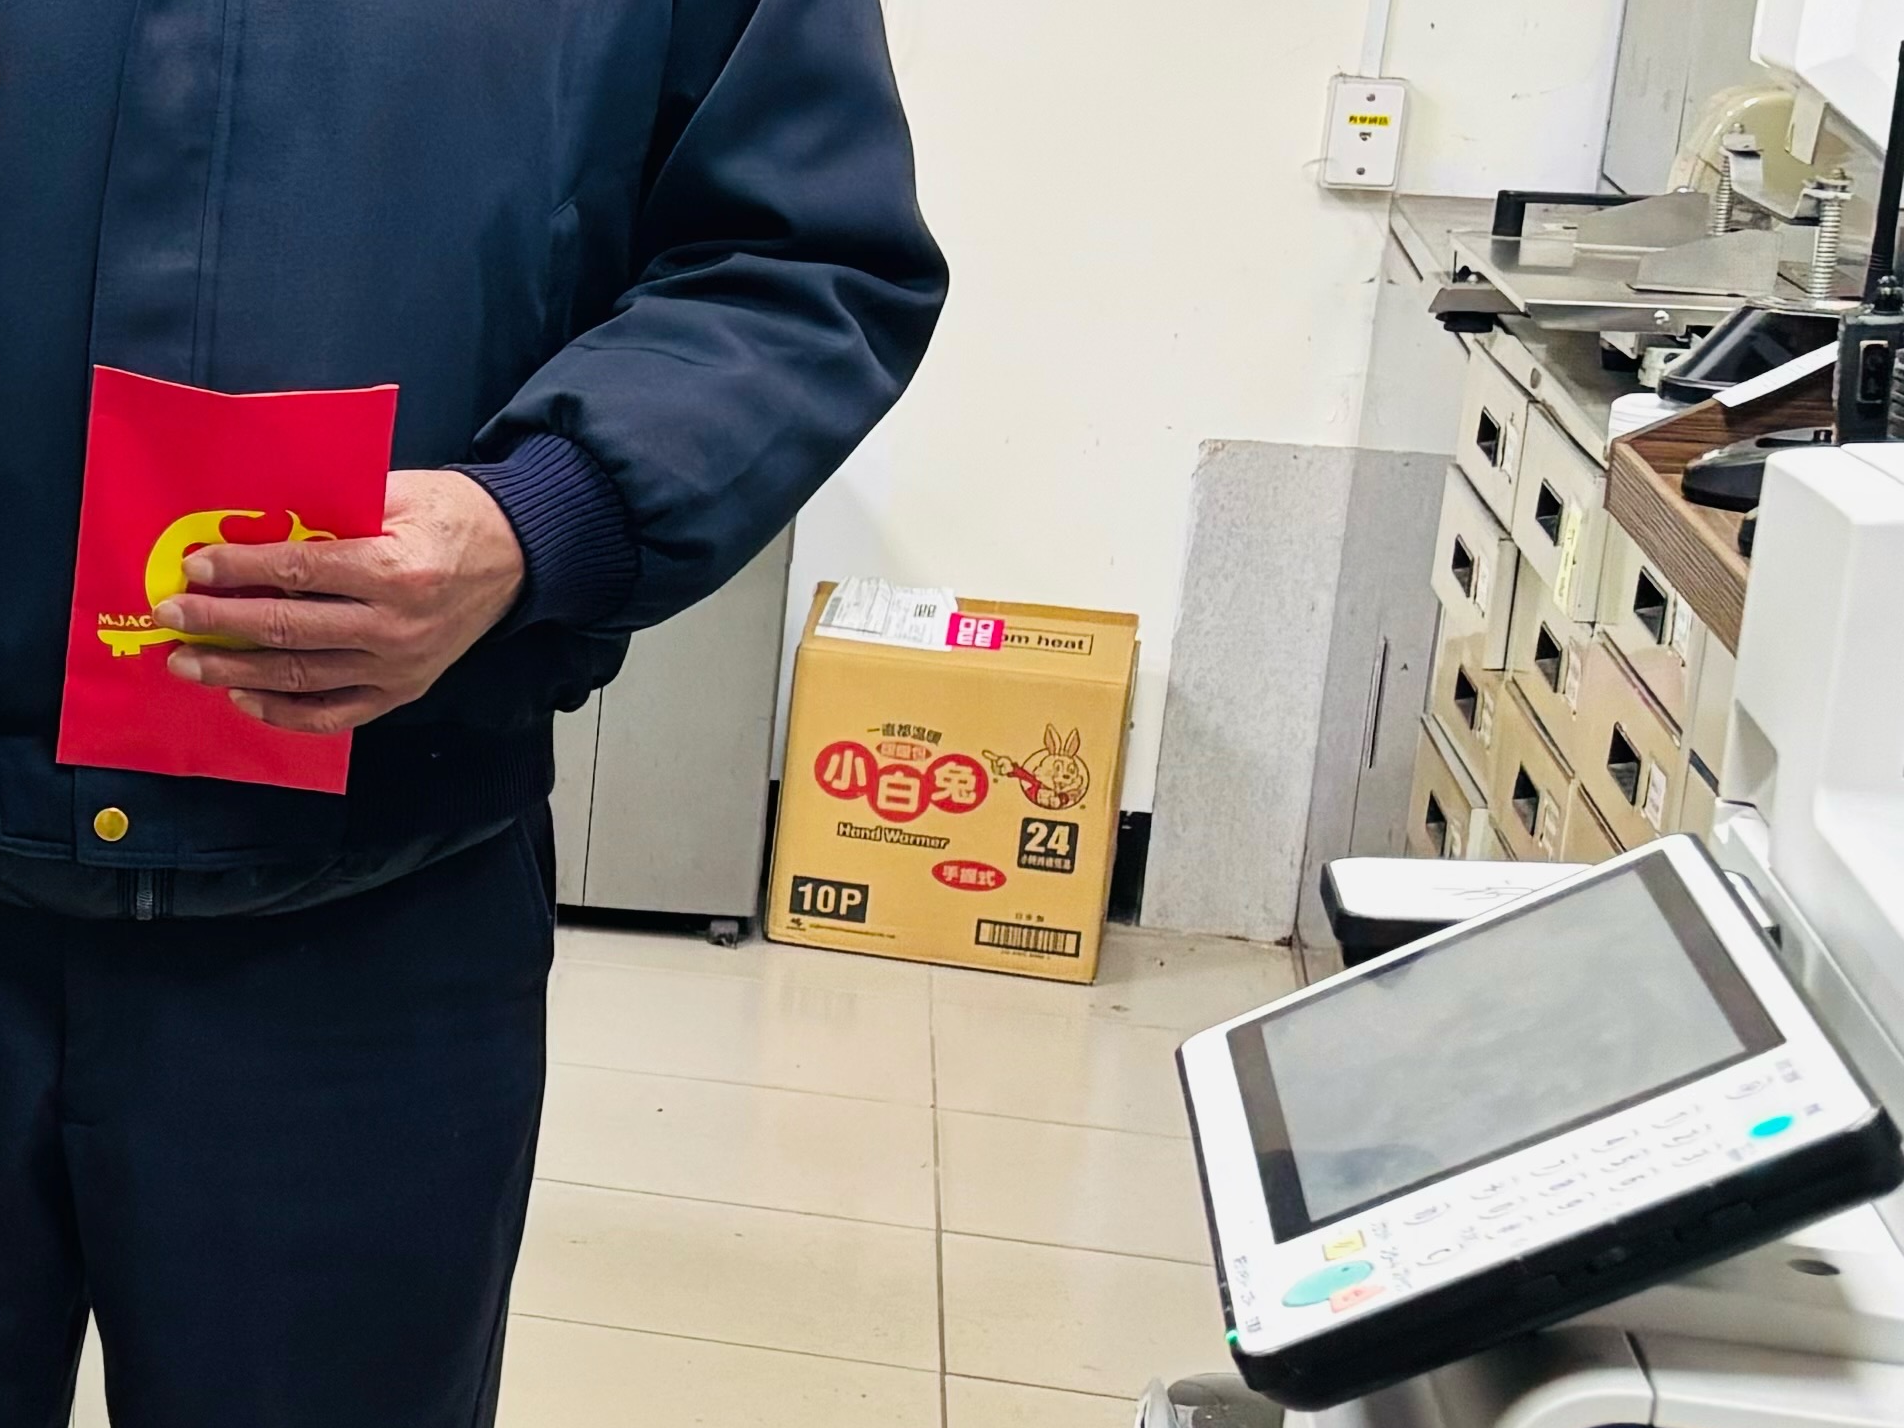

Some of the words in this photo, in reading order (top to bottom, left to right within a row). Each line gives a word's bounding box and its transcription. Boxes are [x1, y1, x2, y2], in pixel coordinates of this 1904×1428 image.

[98, 612, 152, 628] MJAC
[1037, 634, 1084, 650] heat
[824, 750, 977, 813] 小白兔
[837, 821, 881, 841] Hand
[885, 826, 950, 849] Warmer
[1023, 821, 1070, 856] 24
[797, 882, 863, 915] 10P
